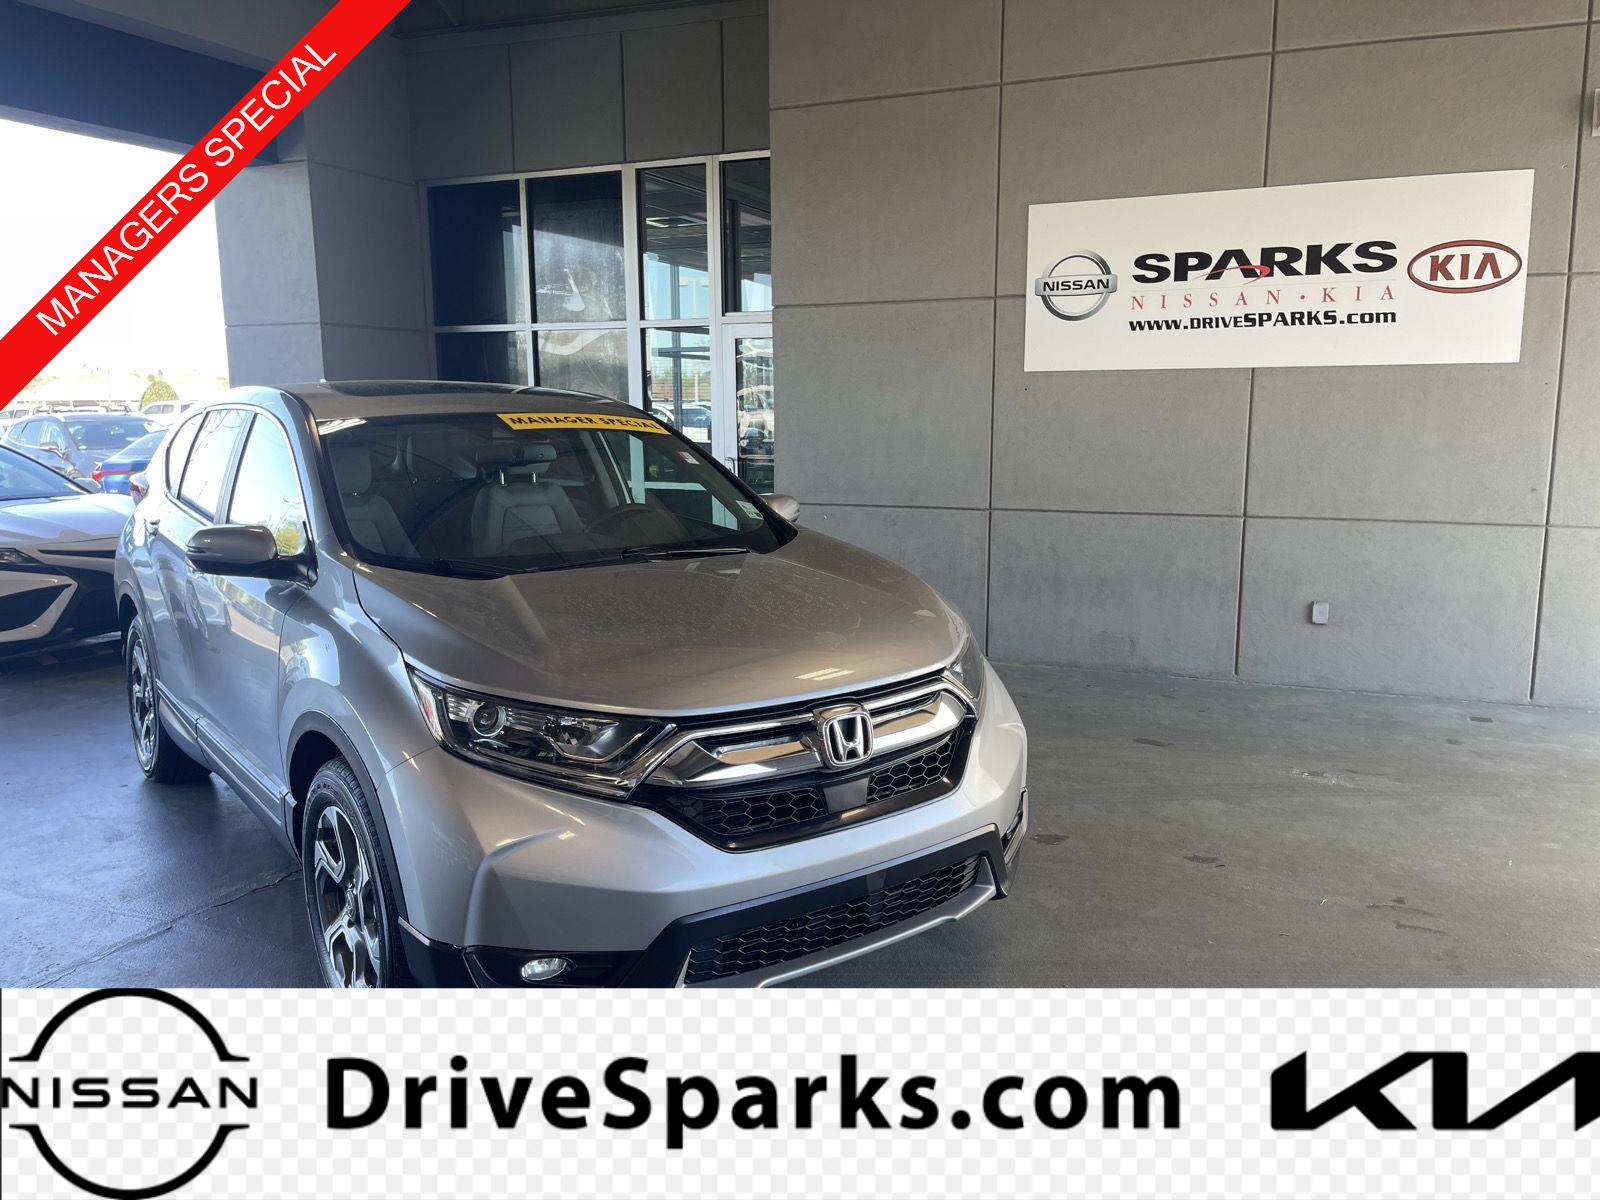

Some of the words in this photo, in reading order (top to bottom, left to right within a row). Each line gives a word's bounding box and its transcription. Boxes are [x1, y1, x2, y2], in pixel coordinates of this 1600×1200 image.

[1132, 240, 1398, 284] SPARKS
[1429, 252, 1502, 281] KIA
[1042, 278, 1110, 292] NISSAN
[1130, 290, 1280, 310] NISSAN
[1322, 285, 1394, 303] KIA
[509, 416, 597, 425] MANAGER
[599, 417, 659, 430] SPECIAL
